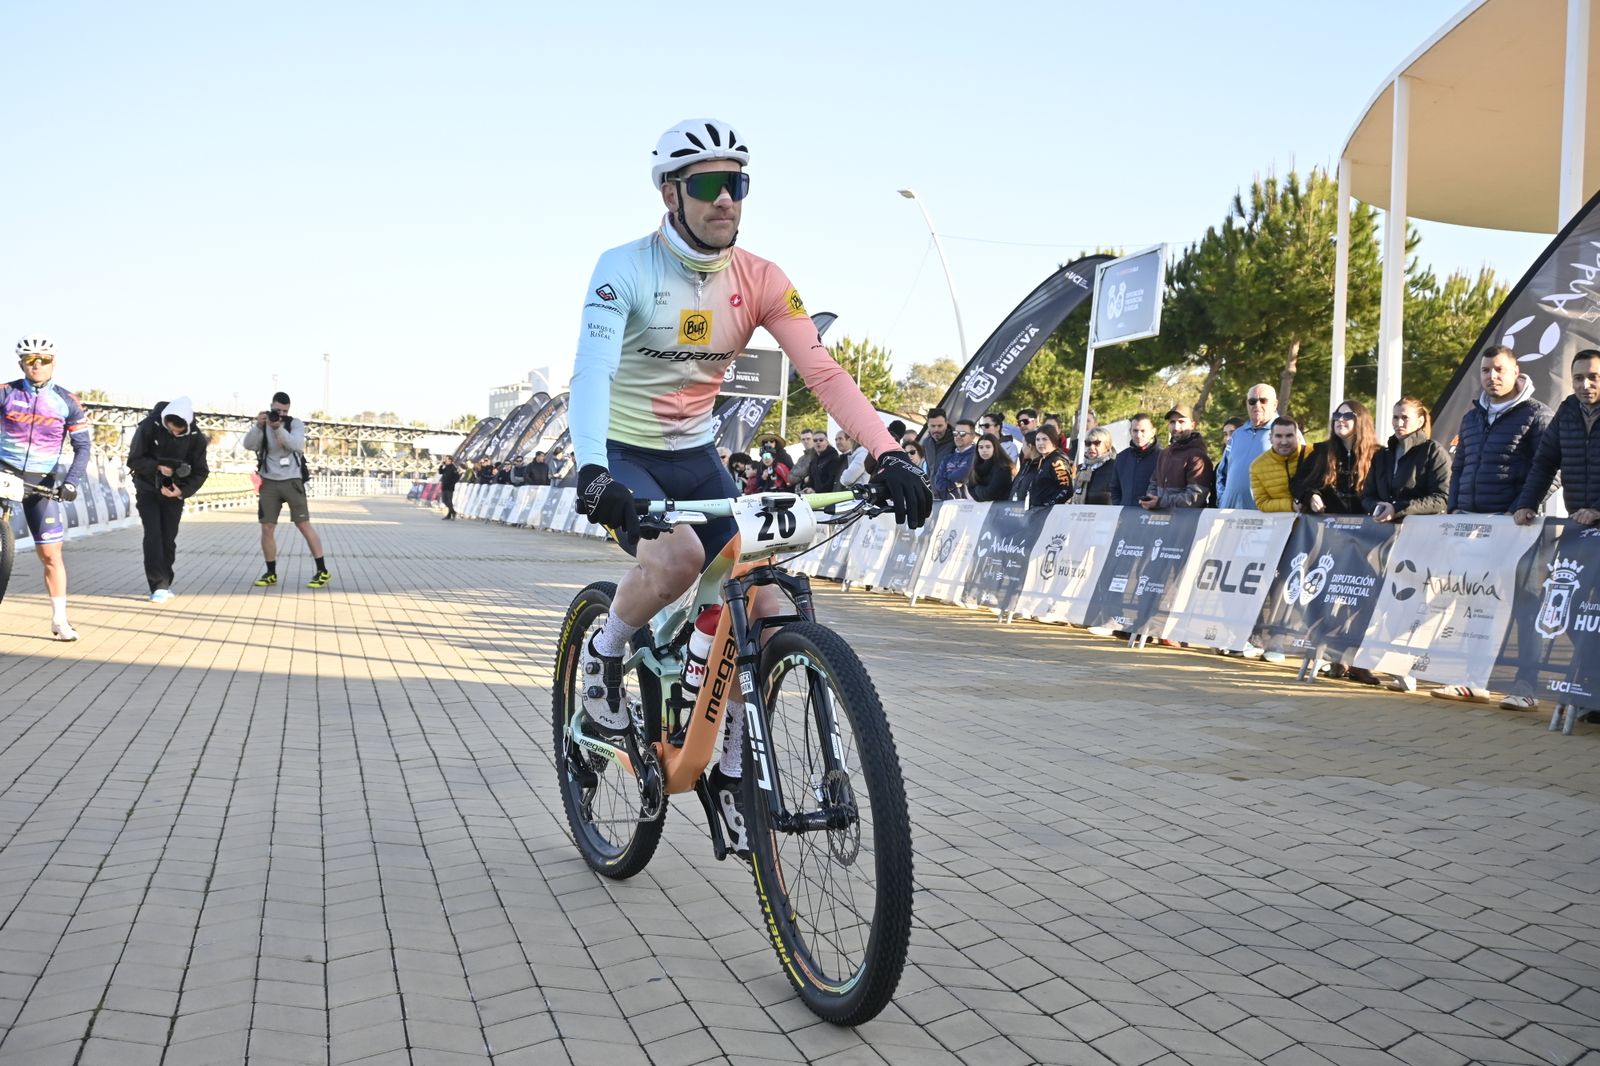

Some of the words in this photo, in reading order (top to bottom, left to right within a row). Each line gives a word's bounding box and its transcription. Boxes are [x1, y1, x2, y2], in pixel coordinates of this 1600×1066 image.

[1540, 241, 1600, 315] And
[637, 346, 736, 362] megamo
[995, 326, 1040, 374] HUELVA
[755, 510, 797, 541] 20
[1328, 584, 1370, 597] PROVINCIAL
[1331, 574, 1375, 587] DIPUTACIÓN
[1421, 567, 1502, 601] Andalucía
[1330, 594, 1357, 606] HUELVA
[1574, 614, 1600, 633] HU
[705, 622, 739, 724] mega
[1551, 680, 1571, 692] UCI
[579, 738, 616, 759] megamo
[760, 893, 791, 964] PIRELLI
